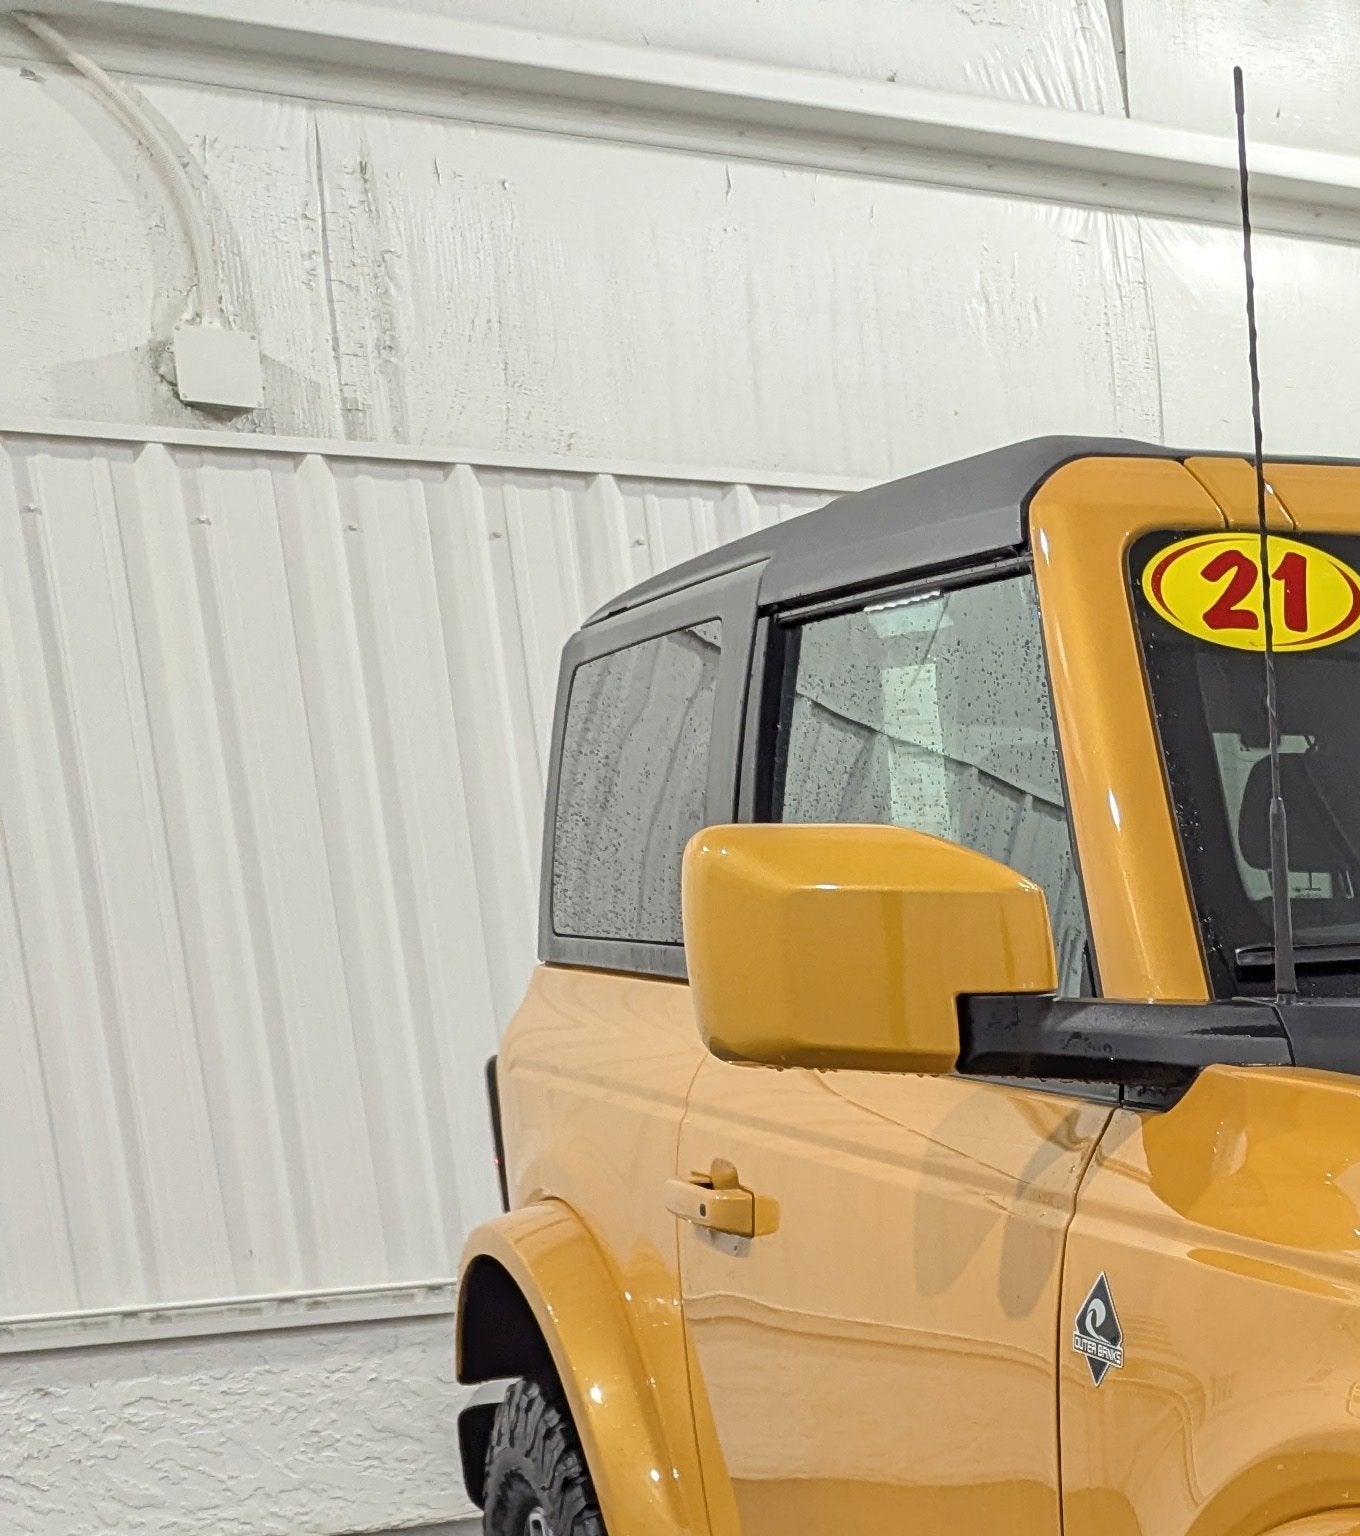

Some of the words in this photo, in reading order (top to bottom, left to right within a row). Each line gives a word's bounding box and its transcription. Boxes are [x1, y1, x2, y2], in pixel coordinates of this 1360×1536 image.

[1200, 549, 1308, 632] 21
[1075, 1336, 1097, 1355] OUTER
[1098, 1344, 1121, 1364] BANKS
